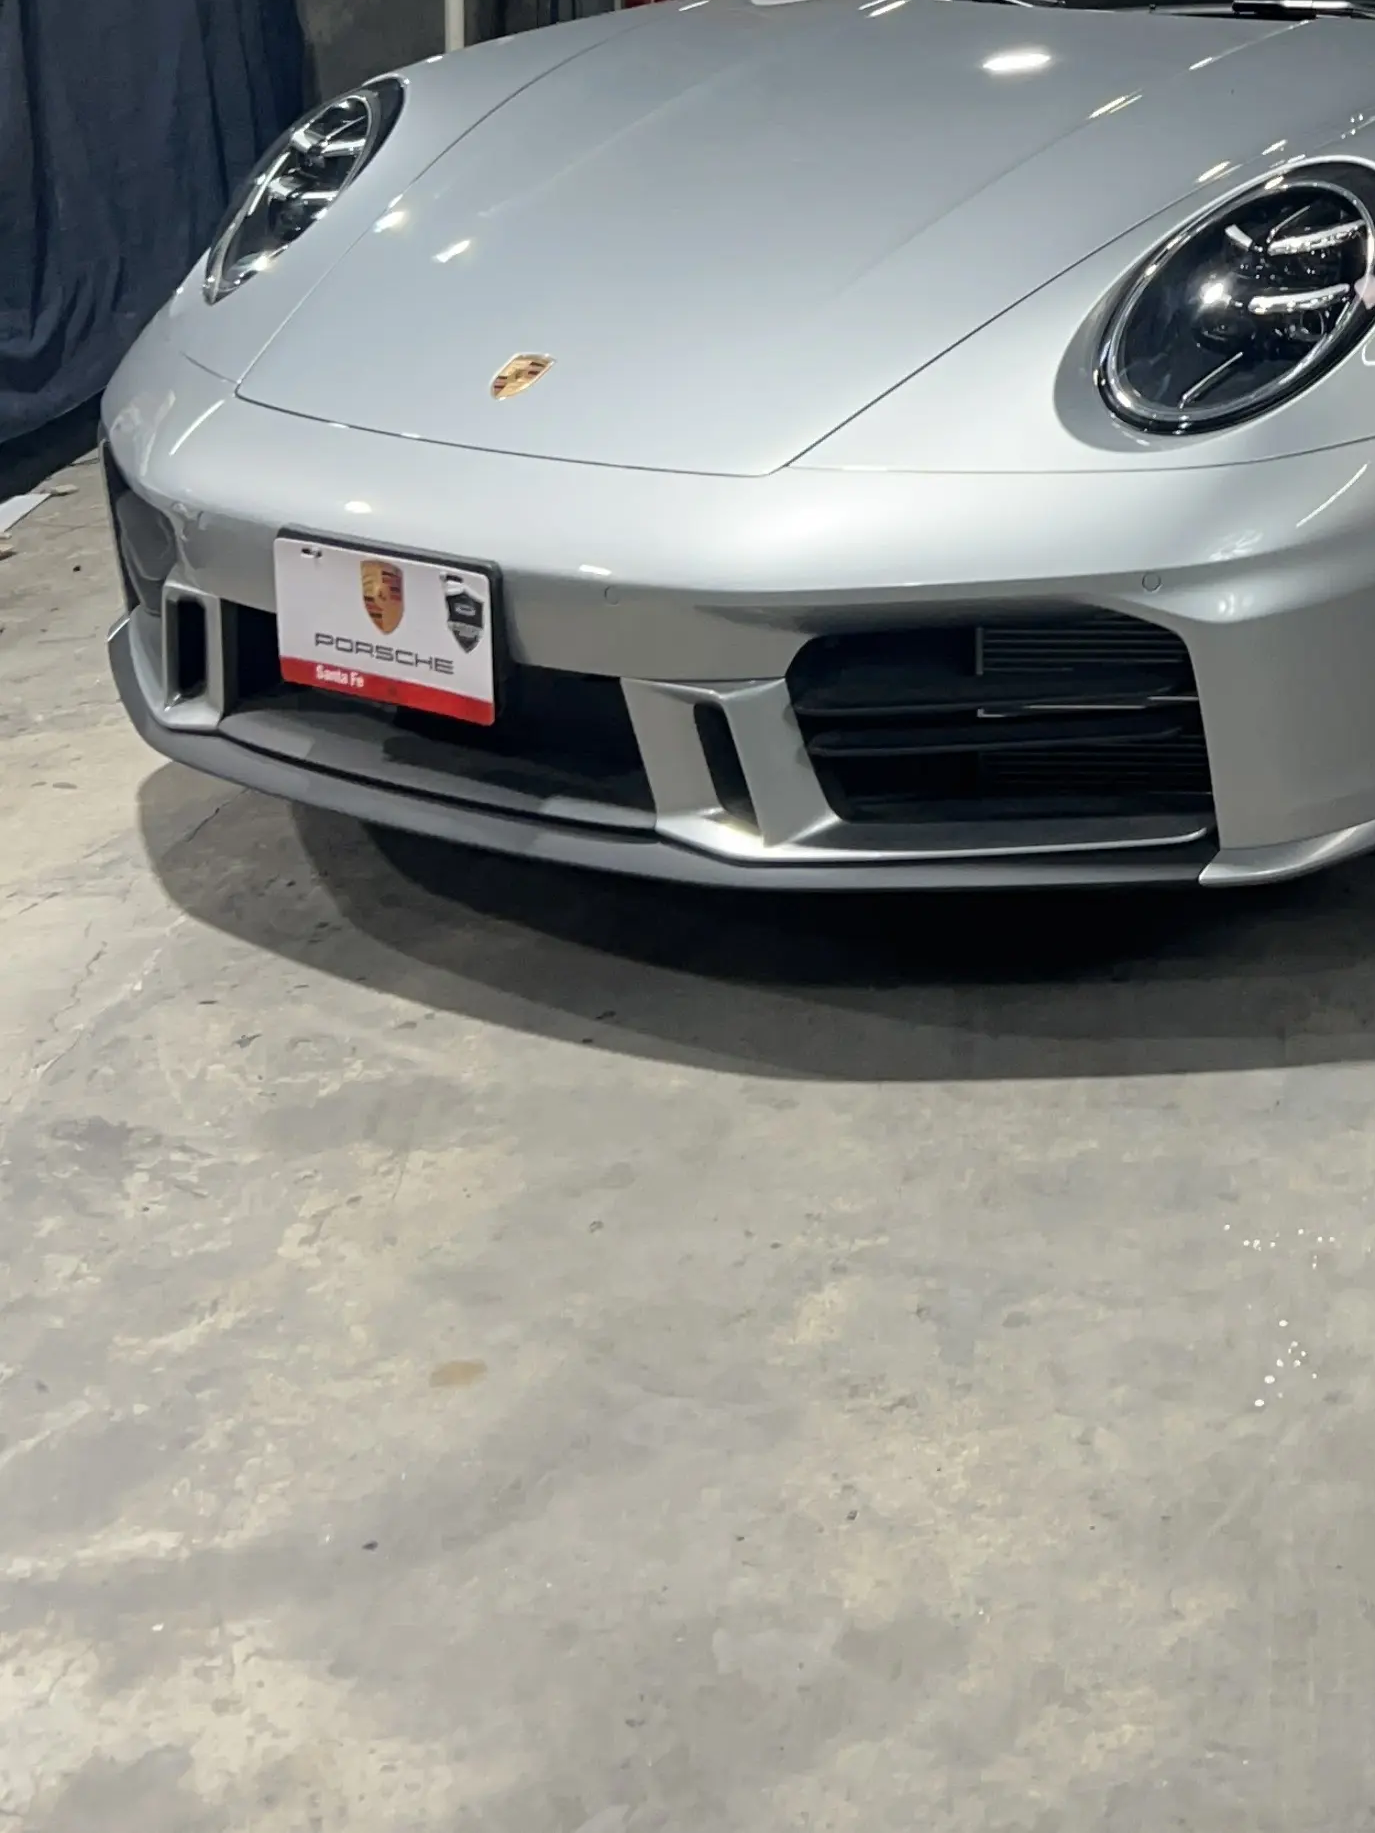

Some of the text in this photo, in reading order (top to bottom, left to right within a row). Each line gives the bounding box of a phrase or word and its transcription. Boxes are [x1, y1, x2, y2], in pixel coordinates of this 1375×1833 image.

[315, 632, 455, 675] PORSCHE
[315, 664, 365, 688] Santa Fe
